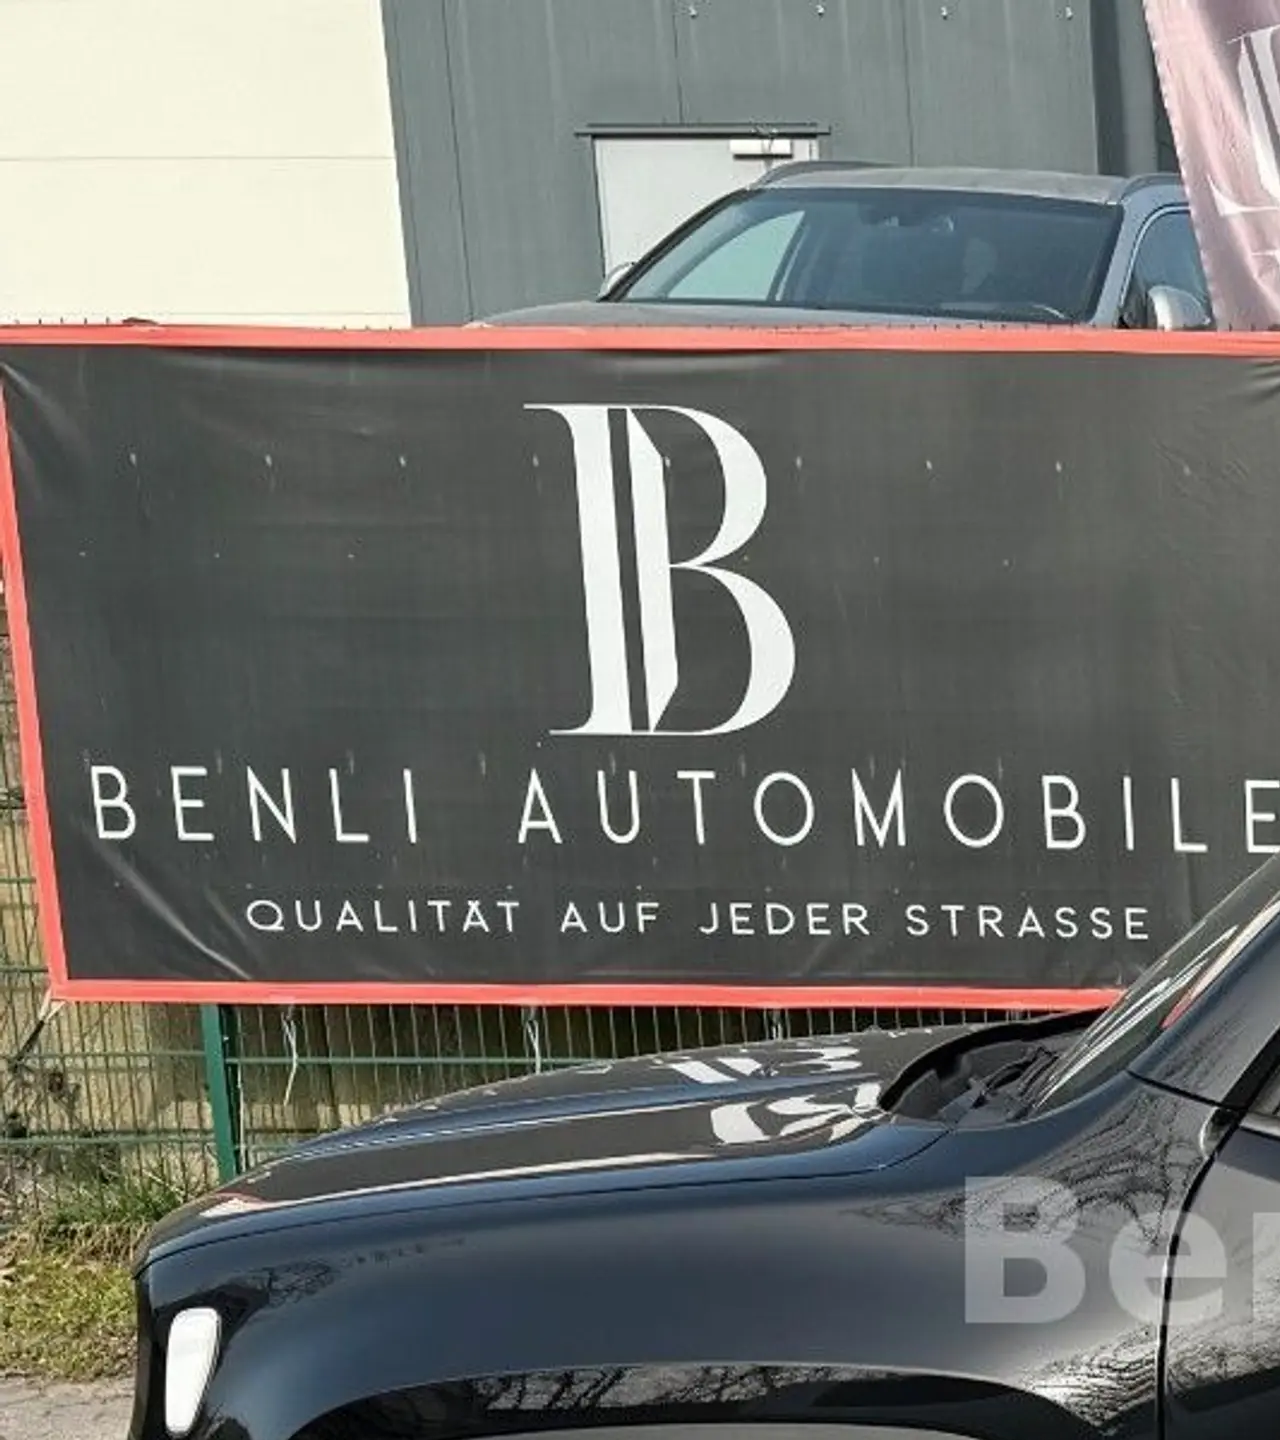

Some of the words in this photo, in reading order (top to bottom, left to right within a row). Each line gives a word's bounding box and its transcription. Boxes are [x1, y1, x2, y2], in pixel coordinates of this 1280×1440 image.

[90, 765, 417, 844] BENLI
[246, 899, 520, 933] QUALITÄT
[561, 901, 659, 933] AUF
[700, 902, 870, 936] JEDER
[905, 904, 1149, 940] STRASSE
